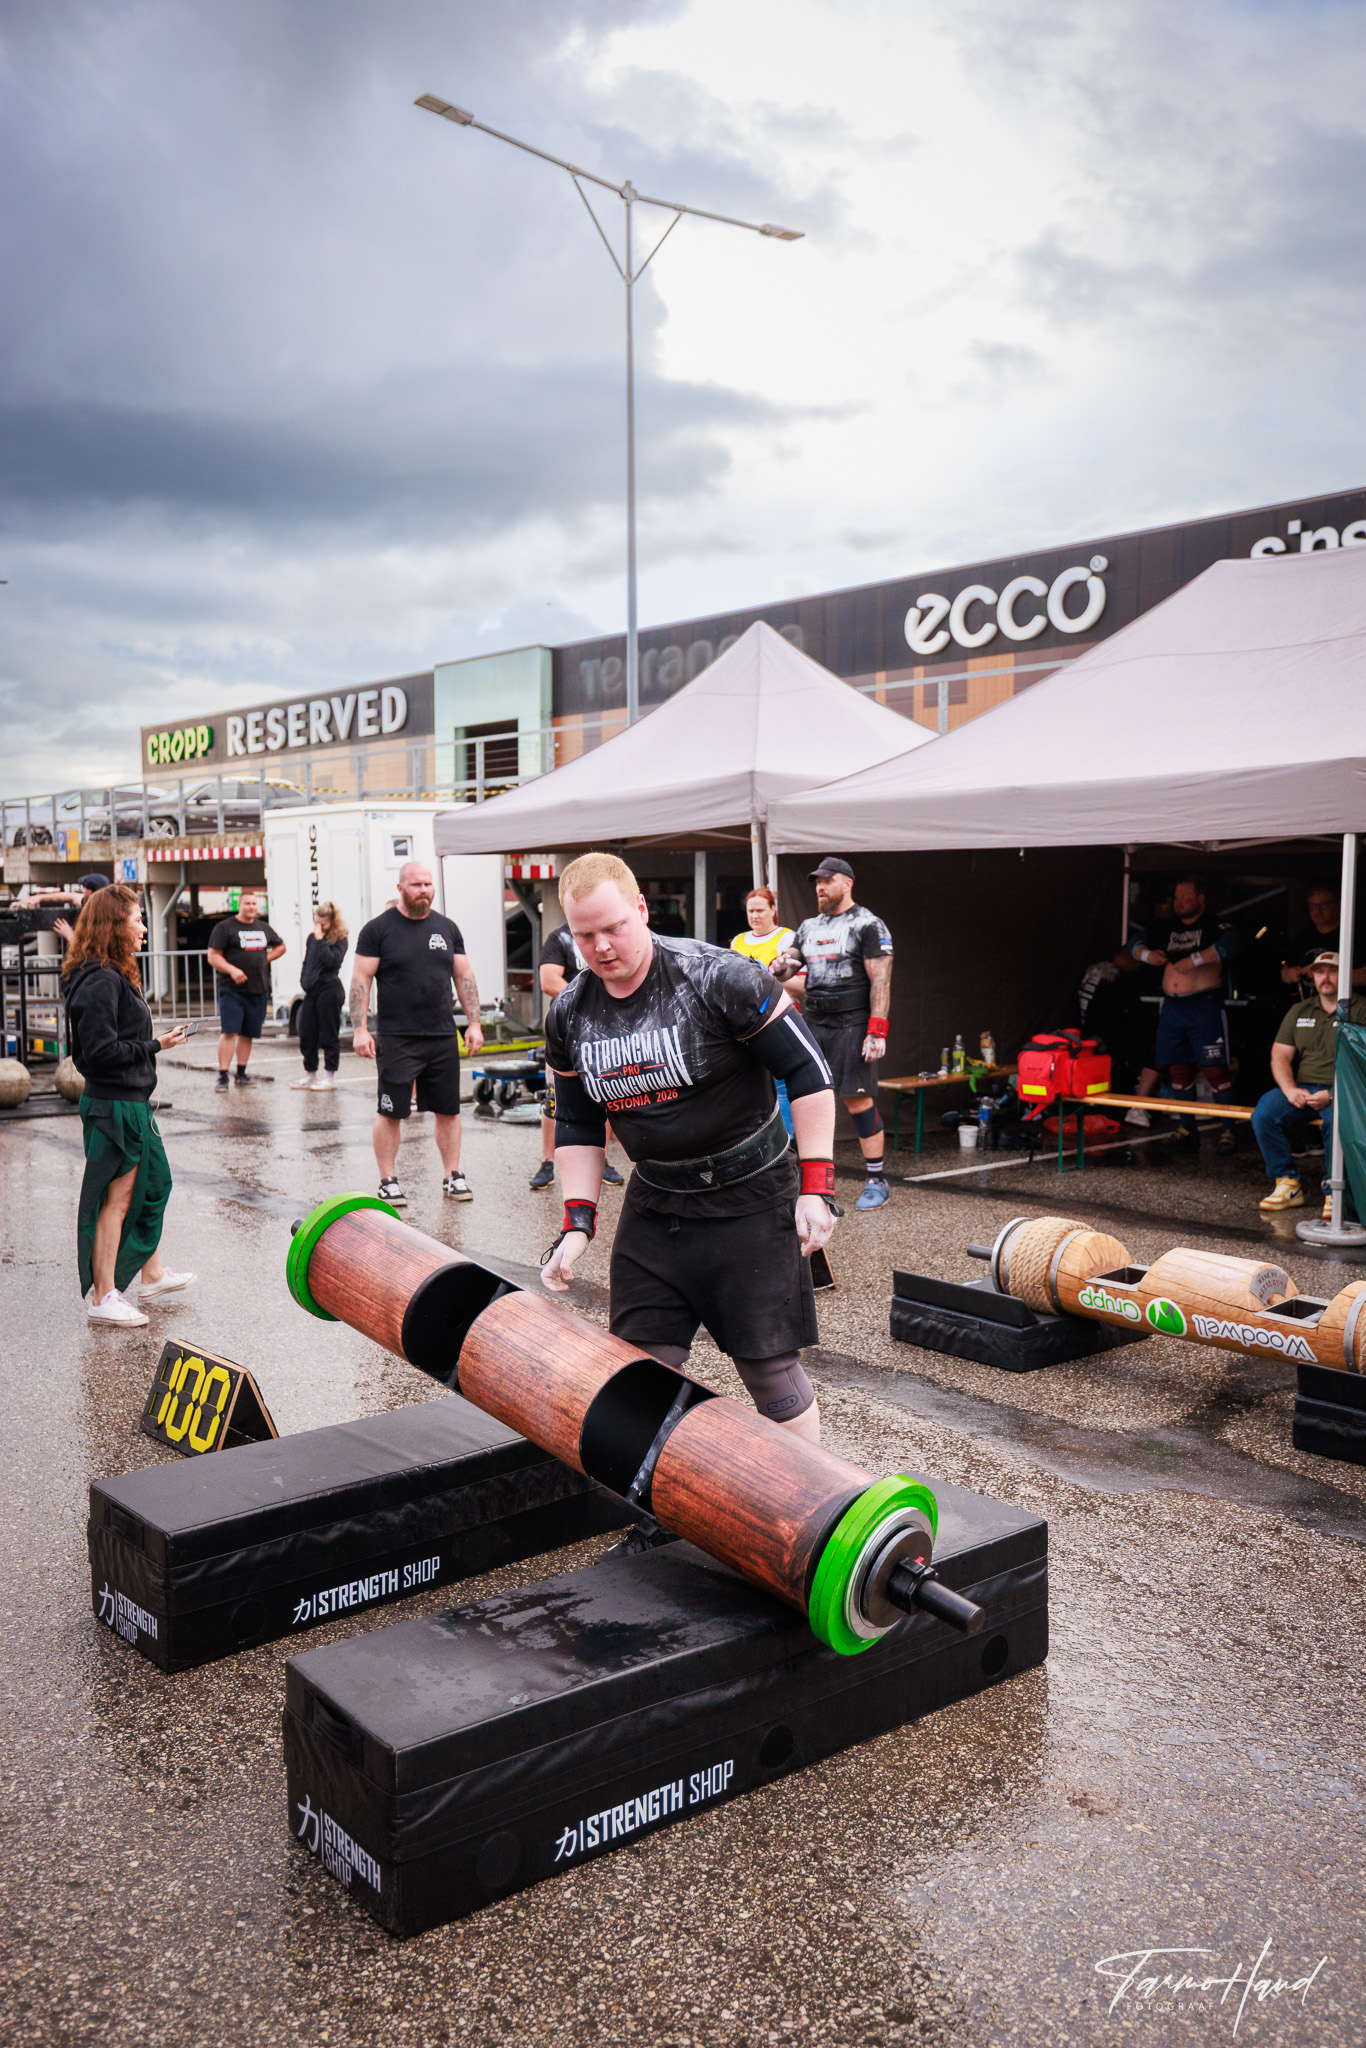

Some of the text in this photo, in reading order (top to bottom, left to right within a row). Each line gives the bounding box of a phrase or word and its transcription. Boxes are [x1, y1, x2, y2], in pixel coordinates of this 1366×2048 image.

[904, 564, 1106, 655] ecco
[147, 725, 212, 765] CROPP
[227, 686, 407, 757] RESERVED
[580, 1025, 693, 1086] STRONGMAN
[585, 1065, 690, 1103] STRONGWOMAN
[622, 1064, 640, 1077] PRO
[606, 1088, 679, 1112] ESTONIA 2026
[1080, 1286, 1316, 1361] Woodwell Grupp
[157, 1352, 231, 1453] 100
[318, 1568, 398, 1615] STRENGTH
[403, 1555, 440, 1588] SHOP
[117, 1591, 158, 1640] STRENGTH
[118, 1614, 138, 1645] SHOP
[586, 1779, 683, 1848] STRENGTH
[689, 1759, 734, 1804] SHOP
[324, 1812, 381, 1893] STRENGTH
[325, 1842, 352, 1888] SHOP
